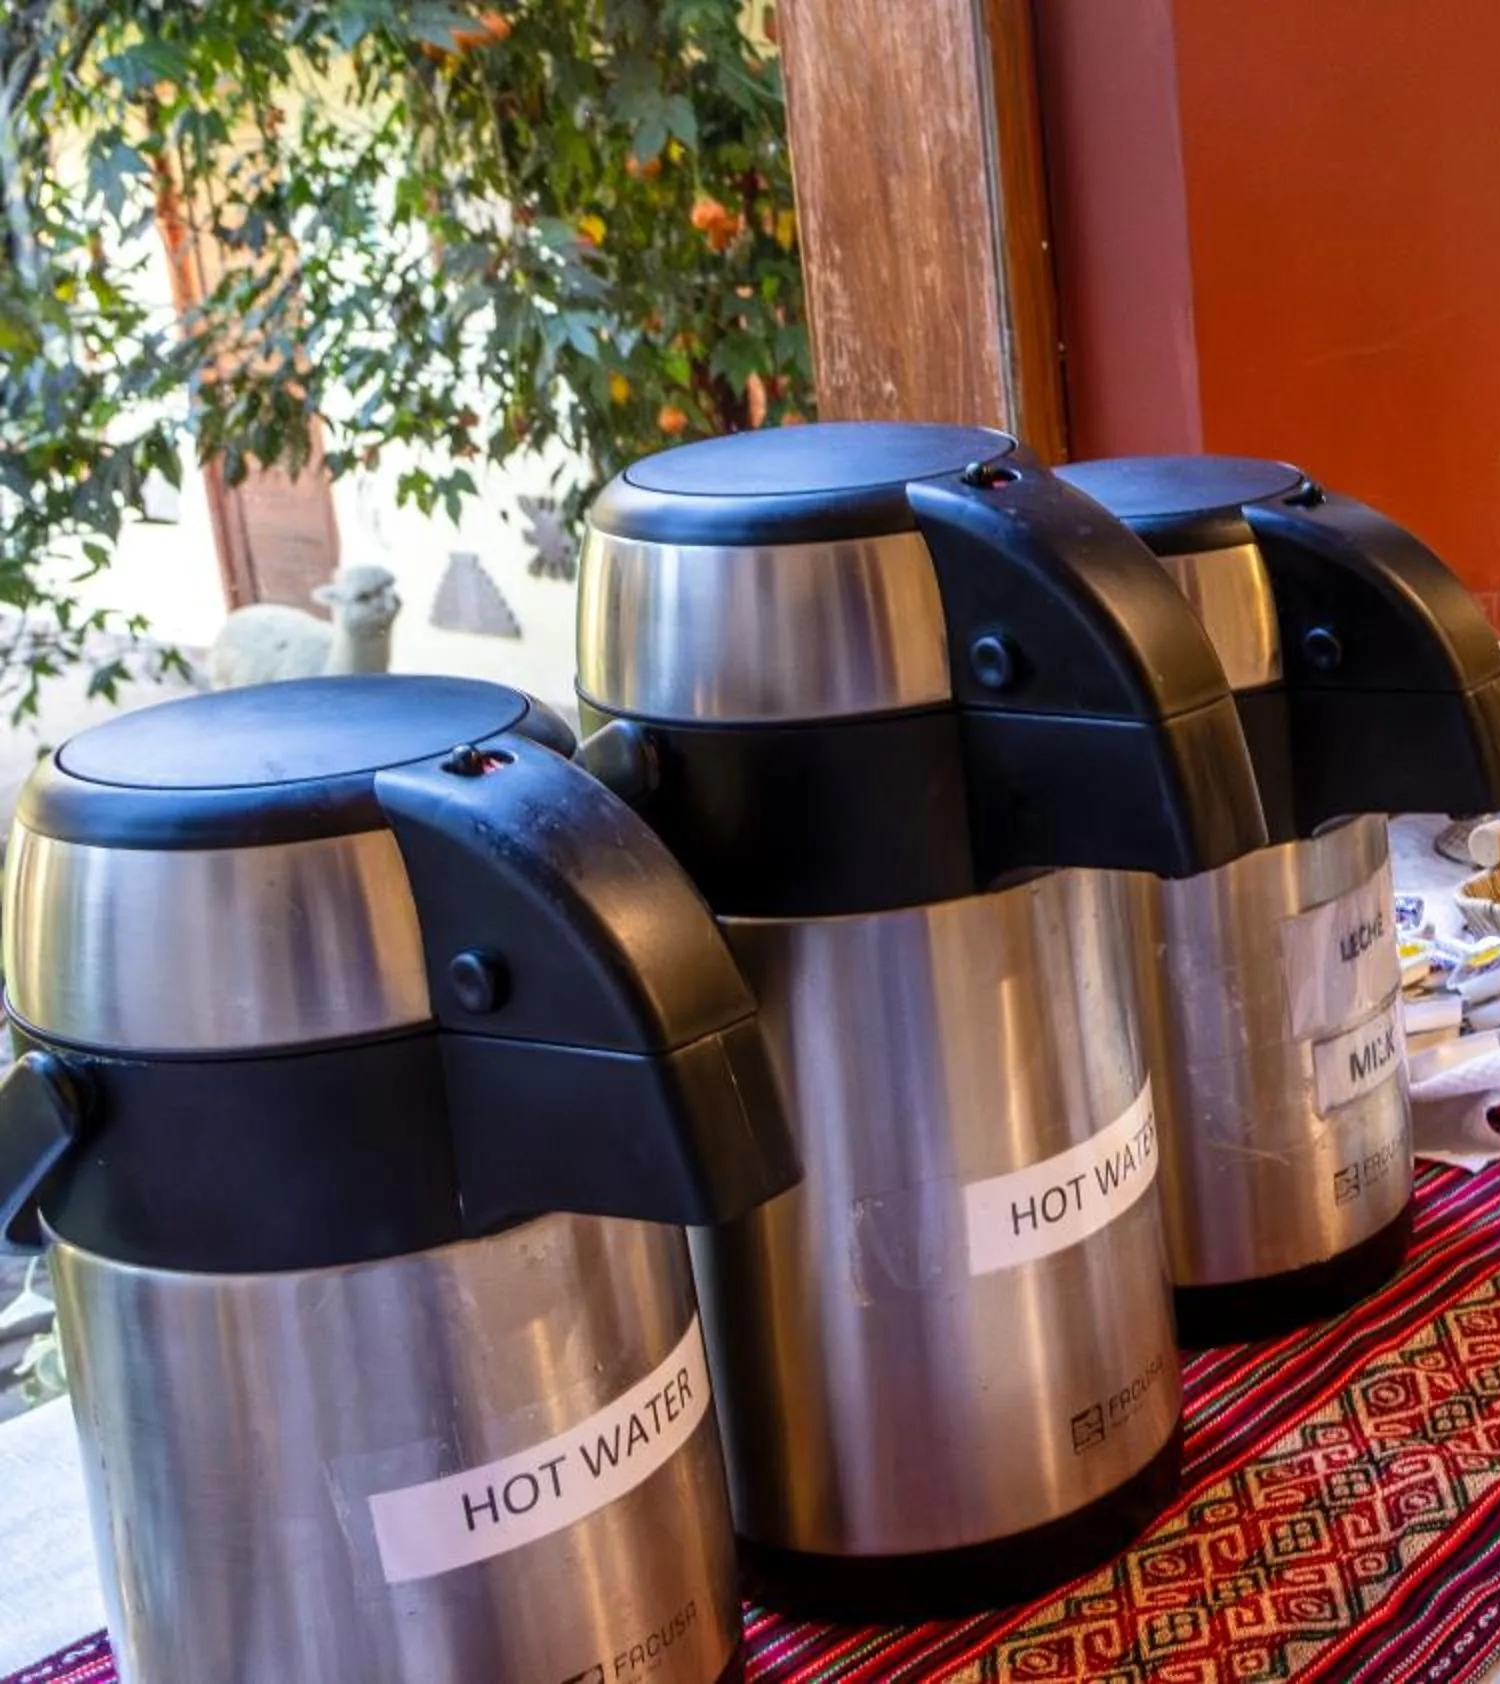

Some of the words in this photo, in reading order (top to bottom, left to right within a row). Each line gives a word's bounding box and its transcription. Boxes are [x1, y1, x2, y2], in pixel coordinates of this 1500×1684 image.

[1340, 911, 1384, 962] LECHE
[1010, 1172, 1087, 1237] HOT
[461, 1454, 567, 1532] HOT
[578, 1366, 693, 1480] WATER
